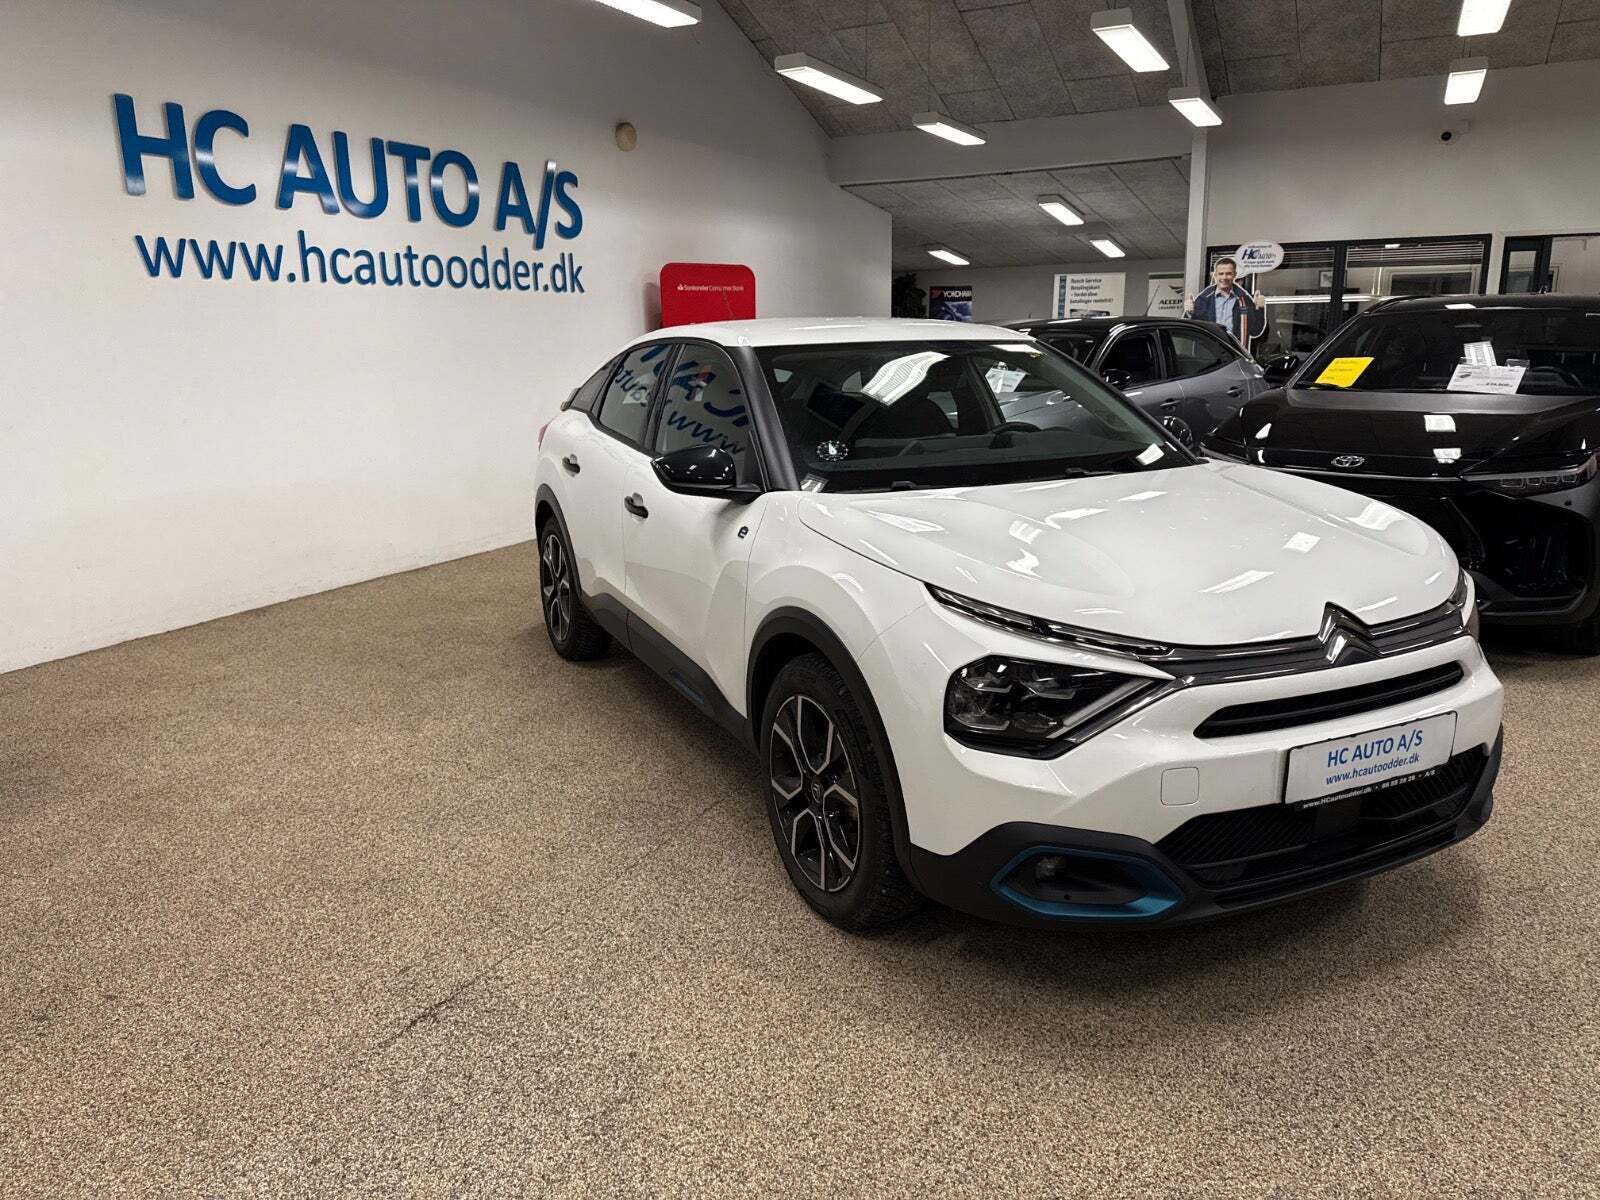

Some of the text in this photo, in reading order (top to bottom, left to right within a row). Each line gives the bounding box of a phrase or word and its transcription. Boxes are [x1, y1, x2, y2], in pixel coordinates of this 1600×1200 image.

[113, 93, 584, 250] HC AUTO A/S
[135, 229, 585, 294] www.hcautoodder.dk
[684, 284, 709, 292] Santander
[943, 290, 972, 298] YOKOHAM
[1327, 729, 1423, 768] HC AUTO A/S
[1326, 753, 1419, 784] www.hcautoodder.dk
